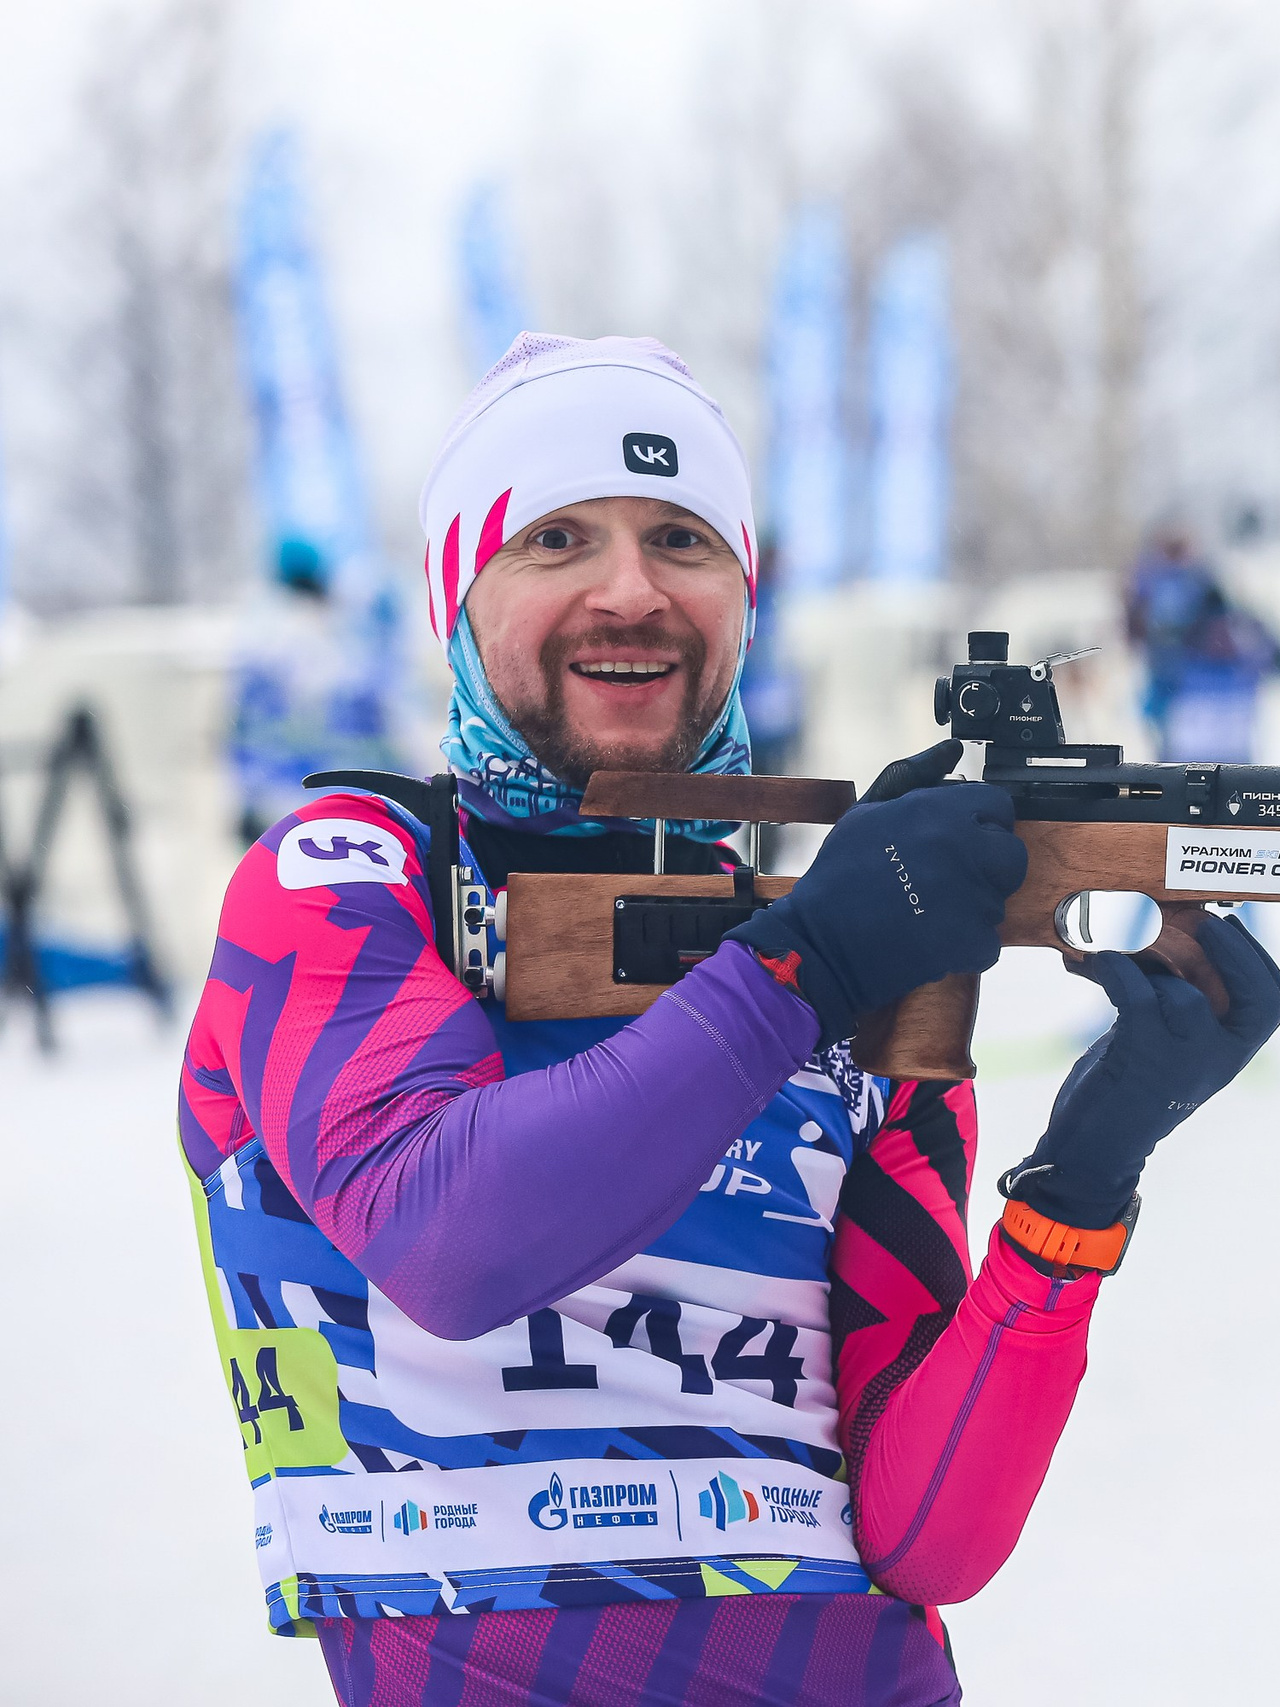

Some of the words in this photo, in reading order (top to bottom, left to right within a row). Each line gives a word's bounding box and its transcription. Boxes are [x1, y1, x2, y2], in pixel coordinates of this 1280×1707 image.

[1181, 845, 1251, 858] УРАЛХИМ
[1180, 860, 1266, 876] PIONER
[885, 844, 925, 915] FORCLAZ
[569, 1483, 658, 1509] ГАЗПРОМ
[761, 1484, 824, 1509] РОДНЫЕ
[433, 1503, 479, 1516] РОДНЫЕ
[768, 1505, 822, 1529] ГОРОДА
[331, 1510, 372, 1525] ГАЗПРОМ
[435, 1516, 477, 1530] ГОРОДА
[576, 1514, 655, 1527] НЕФТЬ
